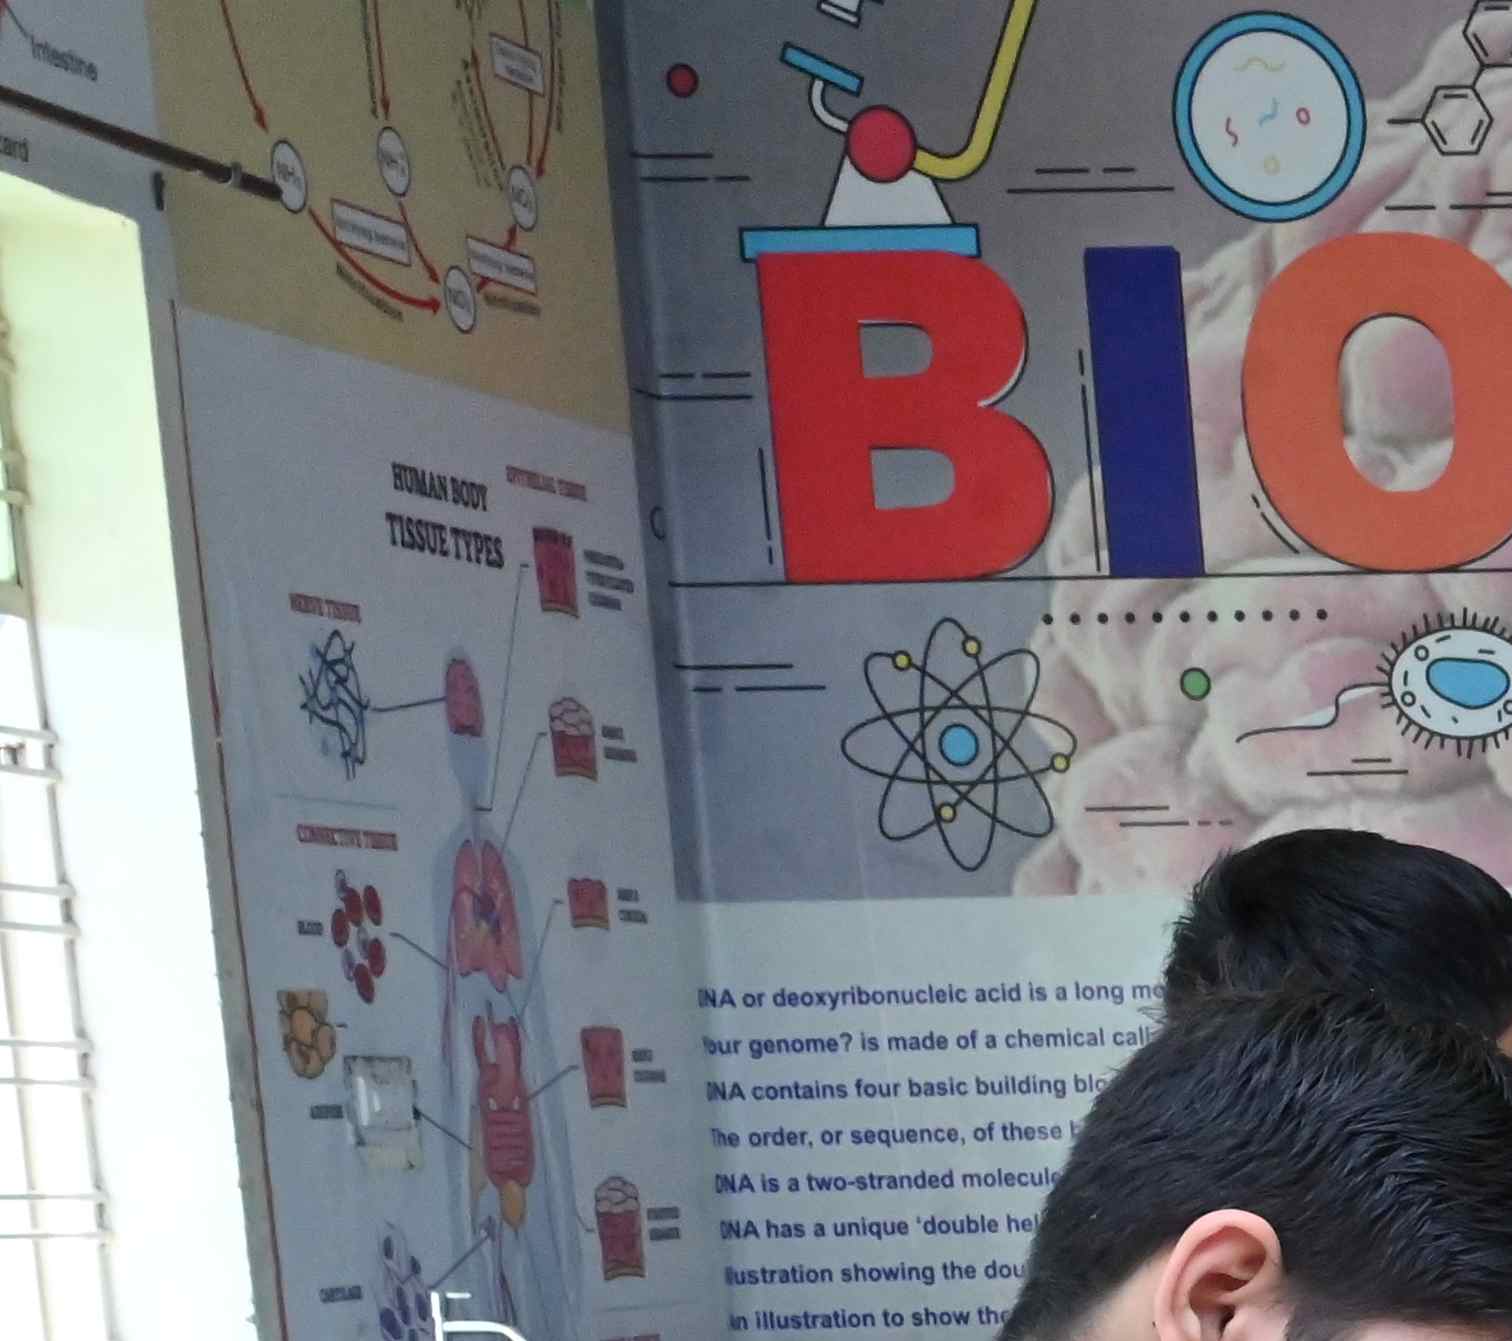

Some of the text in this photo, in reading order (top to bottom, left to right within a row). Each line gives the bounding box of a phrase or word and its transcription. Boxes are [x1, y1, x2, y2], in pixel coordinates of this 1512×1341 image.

[392, 462, 488, 511] HUMAN BODY
[385, 511, 505, 570] TISSUE TYPES
[743, 989, 765, 1008] or
[772, 984, 967, 1011] deoxyribonucleic
[975, 978, 1021, 1002] acid
[1028, 979, 1048, 1001] is
[1055, 984, 1067, 1000] a
[1074, 981, 1125, 1006] long
[749, 1032, 853, 1060] genome?
[860, 1029, 880, 1052] is
[887, 1027, 949, 1051] made
[956, 1026, 979, 1050] of
[984, 1034, 997, 1049] a
[1005, 1027, 1105, 1049] chemical
[751, 1079, 848, 1100] contains
[855, 1074, 900, 1098] four
[908, 1072, 969, 1098] basic
[975, 1070, 1067, 1098] building
[748, 1126, 814, 1149] order,
[820, 1126, 843, 1146] or
[851, 1124, 966, 1150] sequence,
[973, 1122, 995, 1143] of
[1001, 1121, 1062, 1142] these
[762, 1173, 781, 1193] is
[787, 1178, 801, 1192] a
[807, 1169, 955, 1192] two-stranded
[766, 1218, 806, 1239] has
[813, 1223, 826, 1238] a
[833, 1218, 909, 1243] unique
[841, 1259, 977, 1286] showing the
[755, 1307, 876, 1330] illustration
[883, 1305, 905, 1327] to
[912, 1304, 970, 1326] show
